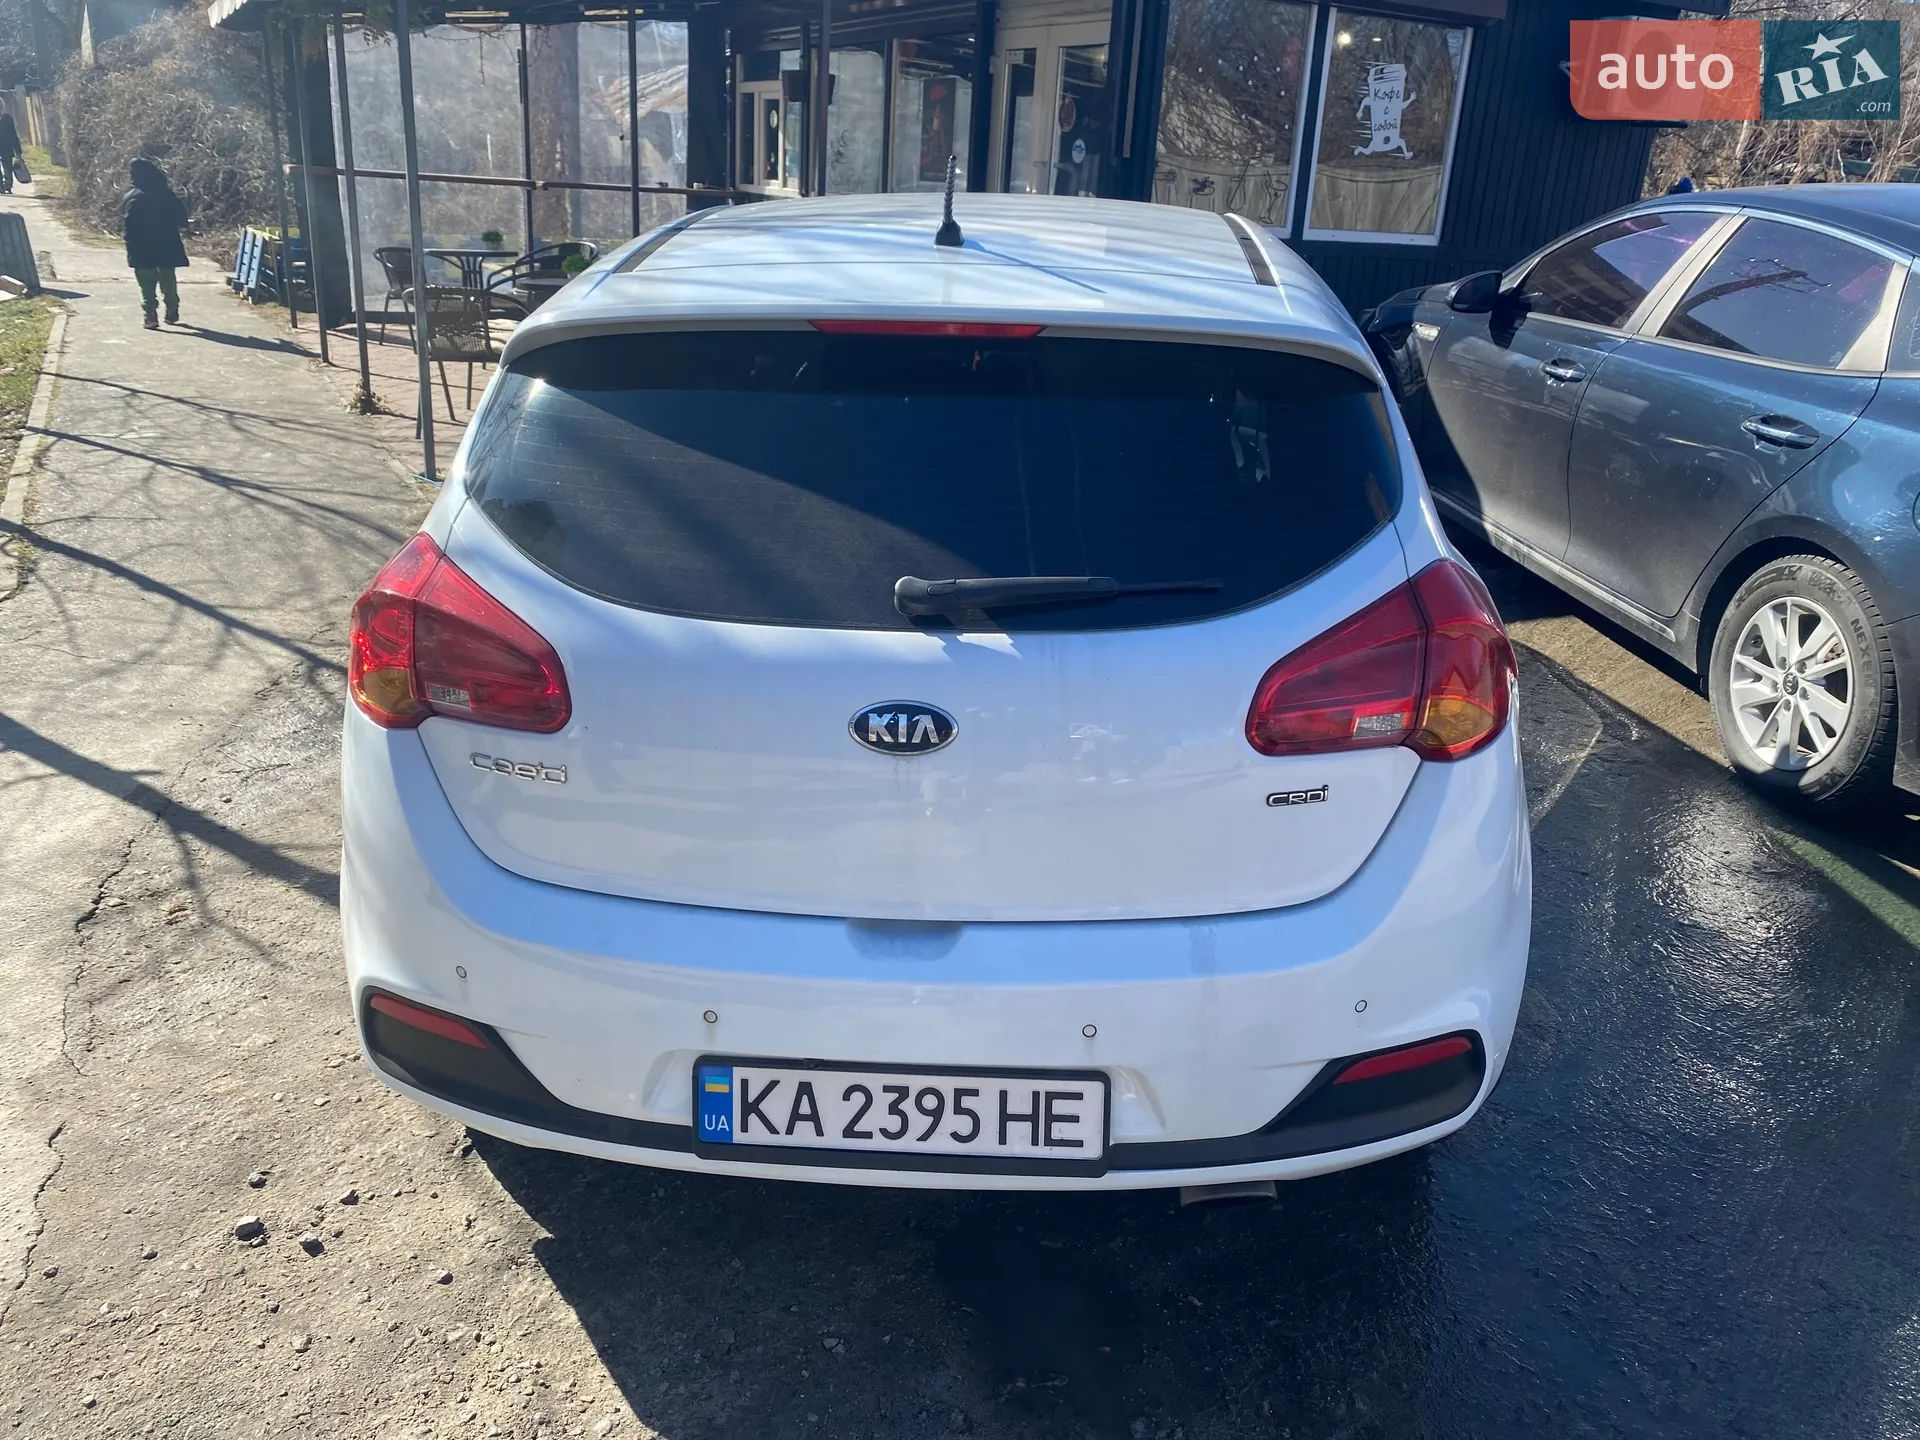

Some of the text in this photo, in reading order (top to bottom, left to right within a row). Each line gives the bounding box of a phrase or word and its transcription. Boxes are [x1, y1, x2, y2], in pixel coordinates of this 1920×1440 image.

[1373, 86, 1401, 103] Кофе
[1373, 118, 1398, 132] собой
[867, 712, 940, 744] KIA
[1266, 784, 1330, 807] CRDi
[704, 1078, 1084, 1148] UA KA 2395 HE
